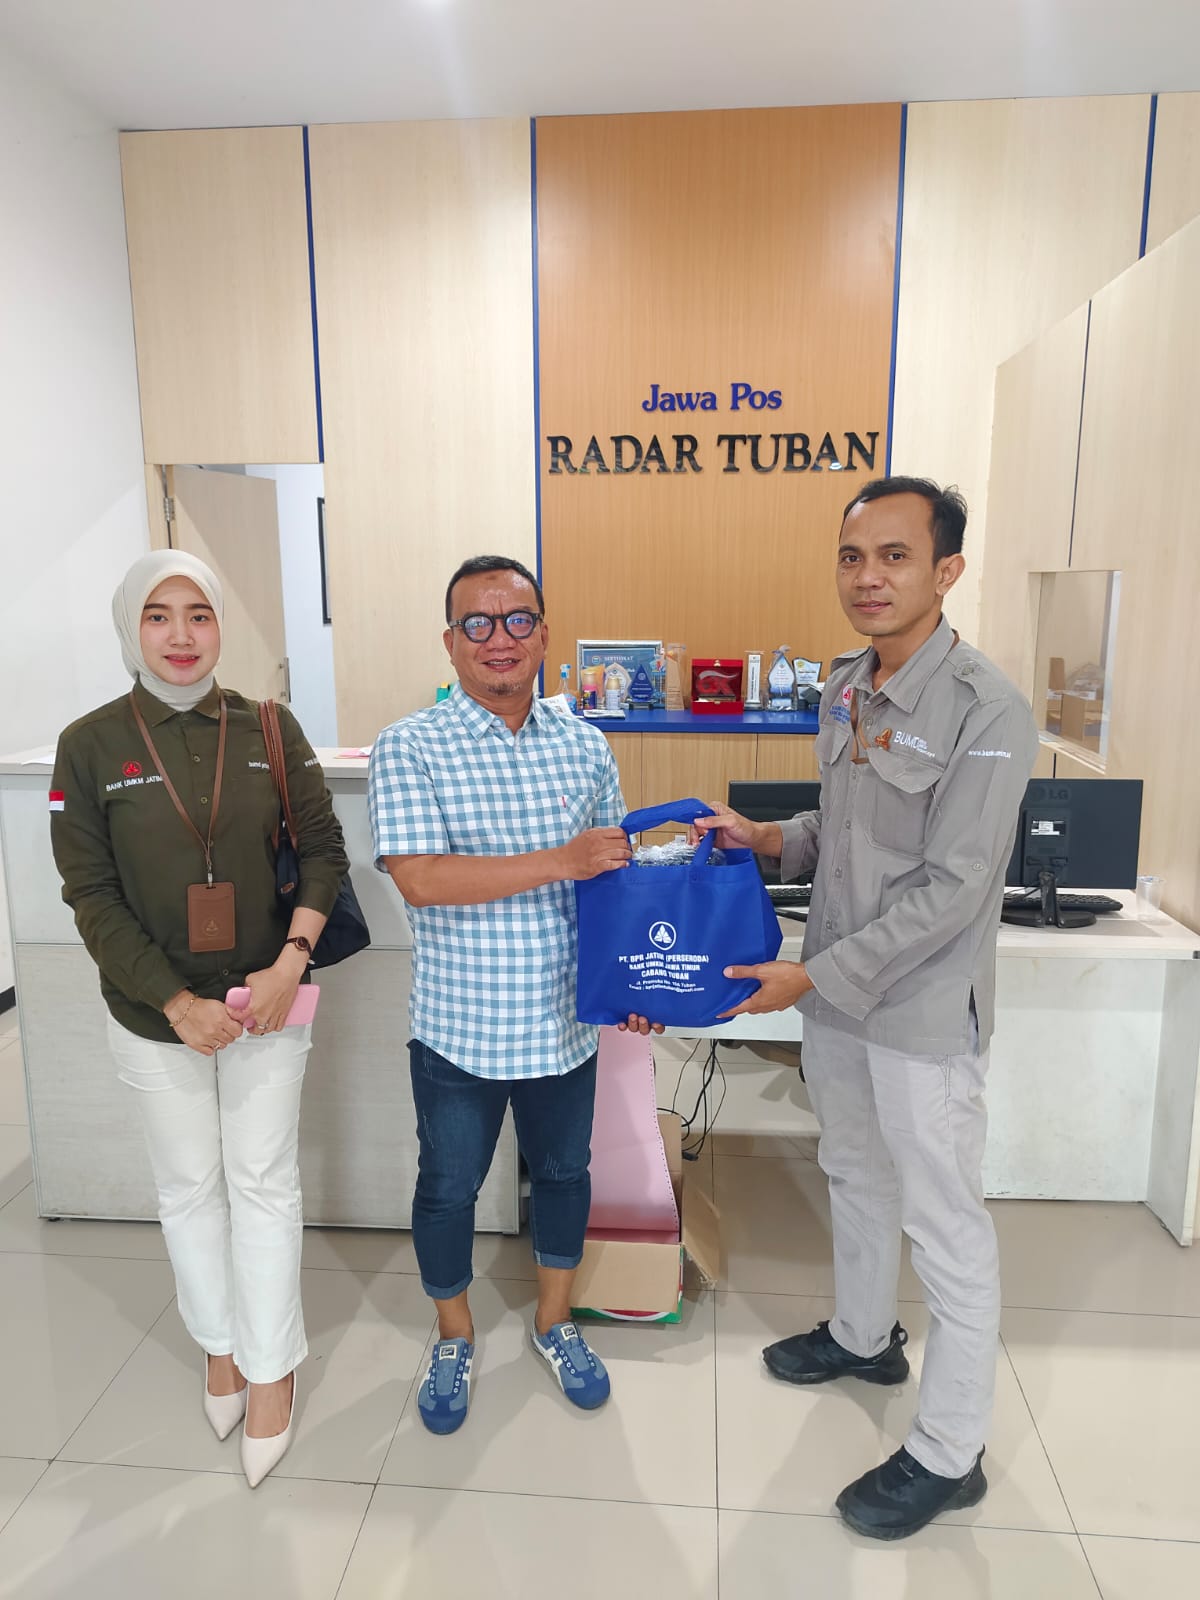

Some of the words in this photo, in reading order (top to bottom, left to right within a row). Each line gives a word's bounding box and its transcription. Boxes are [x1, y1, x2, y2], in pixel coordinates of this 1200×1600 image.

[642, 384, 718, 412] Jawa
[730, 383, 782, 410] Pos
[546, 434, 702, 474] RADAR
[717, 432, 880, 473] TUBAN
[105, 781, 123, 792] BANK
[124, 777, 144, 787] UMKM
[1049, 789, 1068, 800] LG
[618, 955, 629, 963] PT.
[630, 954, 644, 963] BPR
[645, 952, 664, 960] JATIM
[666, 954, 709, 963] (PERSERODA)
[629, 962, 645, 970] BANK
[641, 969, 667, 977] CABANG
[668, 971, 689, 980] TUBAN
